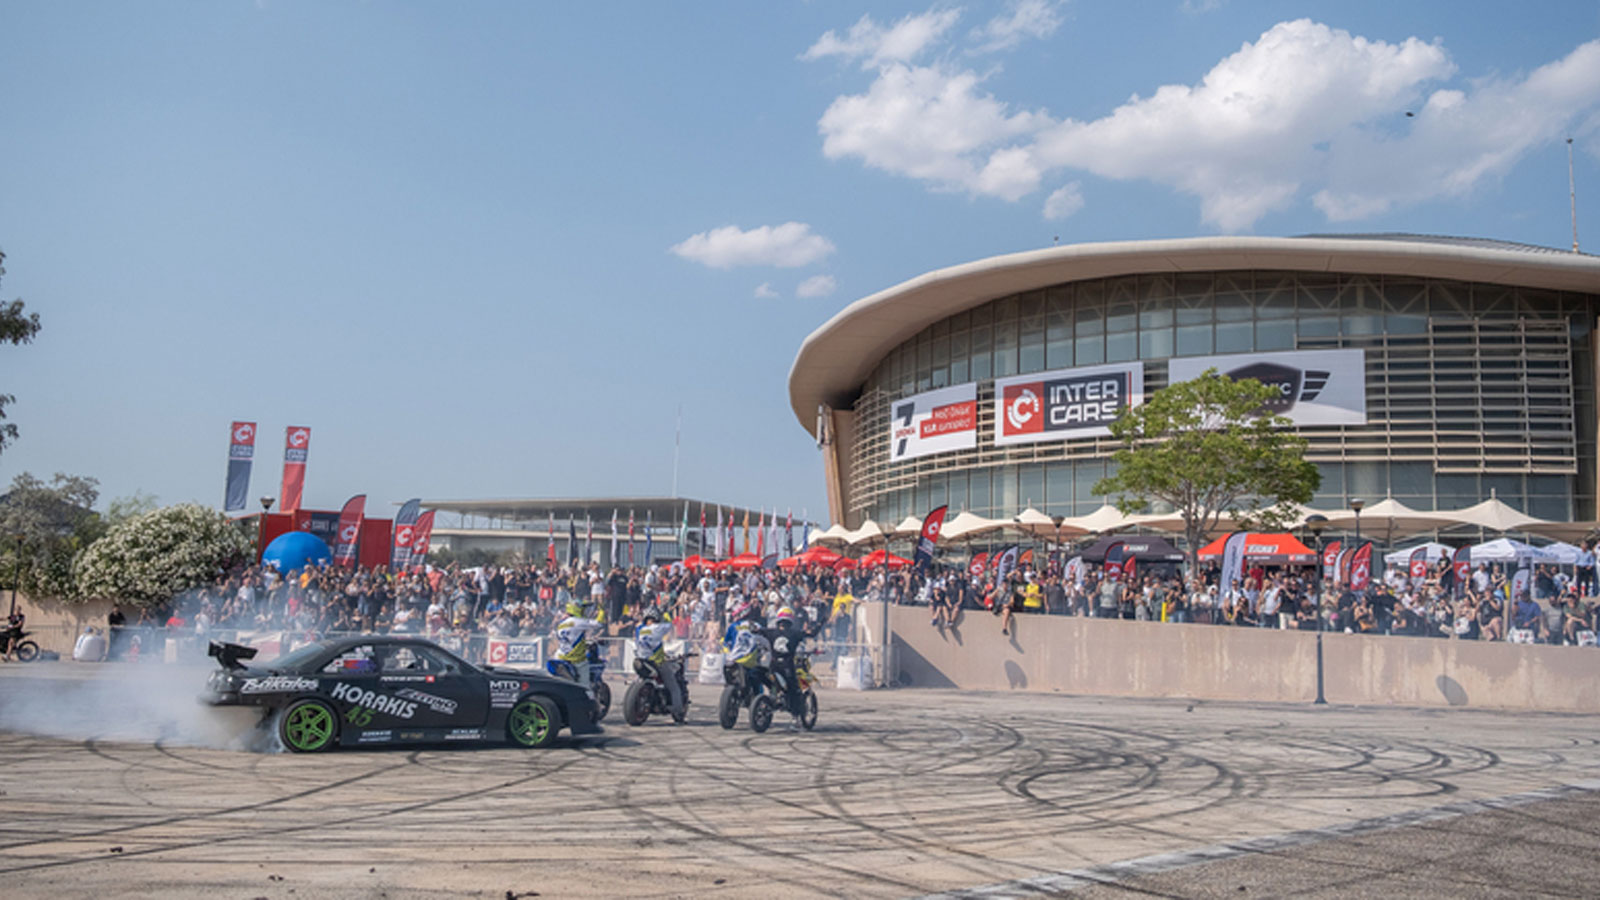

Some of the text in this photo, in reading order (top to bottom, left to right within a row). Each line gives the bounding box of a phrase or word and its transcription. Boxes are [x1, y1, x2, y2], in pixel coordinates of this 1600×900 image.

[1050, 380, 1119, 405] INTER
[1050, 401, 1118, 424] CARS
[489, 680, 521, 690] MTD
[331, 682, 418, 719] KORAKIS
[344, 705, 376, 727] 45
